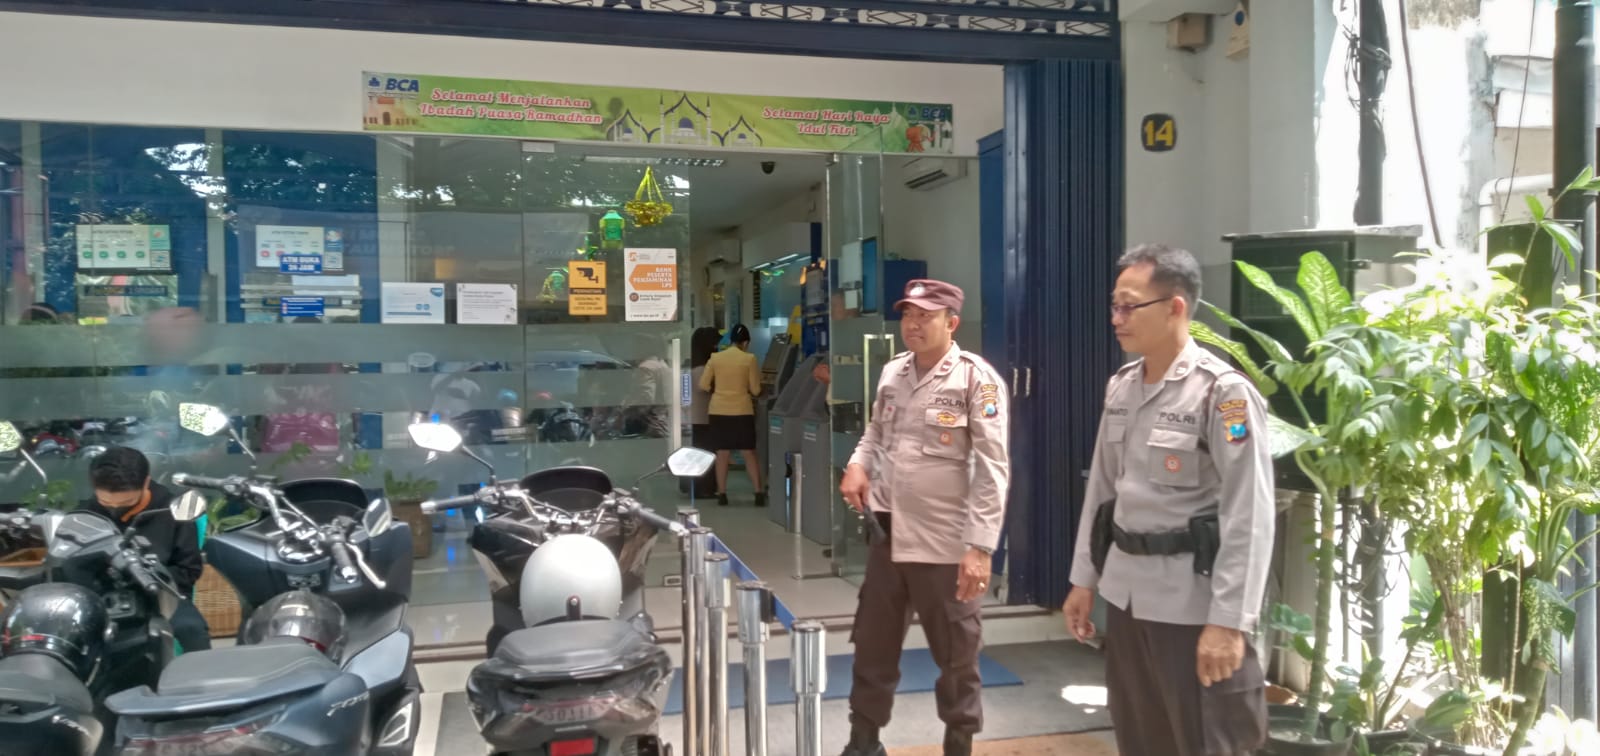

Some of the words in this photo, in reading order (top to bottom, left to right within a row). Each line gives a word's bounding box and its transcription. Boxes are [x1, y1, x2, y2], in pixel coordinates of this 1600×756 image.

[385, 78, 419, 93] BCA
[432, 89, 493, 103] Selamat
[497, 92, 591, 109] Menjalankan
[420, 103, 475, 117] Ibadah
[479, 108, 525, 120] Puasa
[526, 109, 603, 124] Ramadhan
[763, 107, 818, 120] Selamat
[823, 109, 852, 121] Hari
[855, 111, 890, 125] Raya
[798, 124, 826, 135] Idul
[828, 124, 858, 136] Fitri
[1144, 119, 1174, 146] 14
[934, 397, 965, 409] POLRI
[1159, 411, 1196, 425] POLRI
